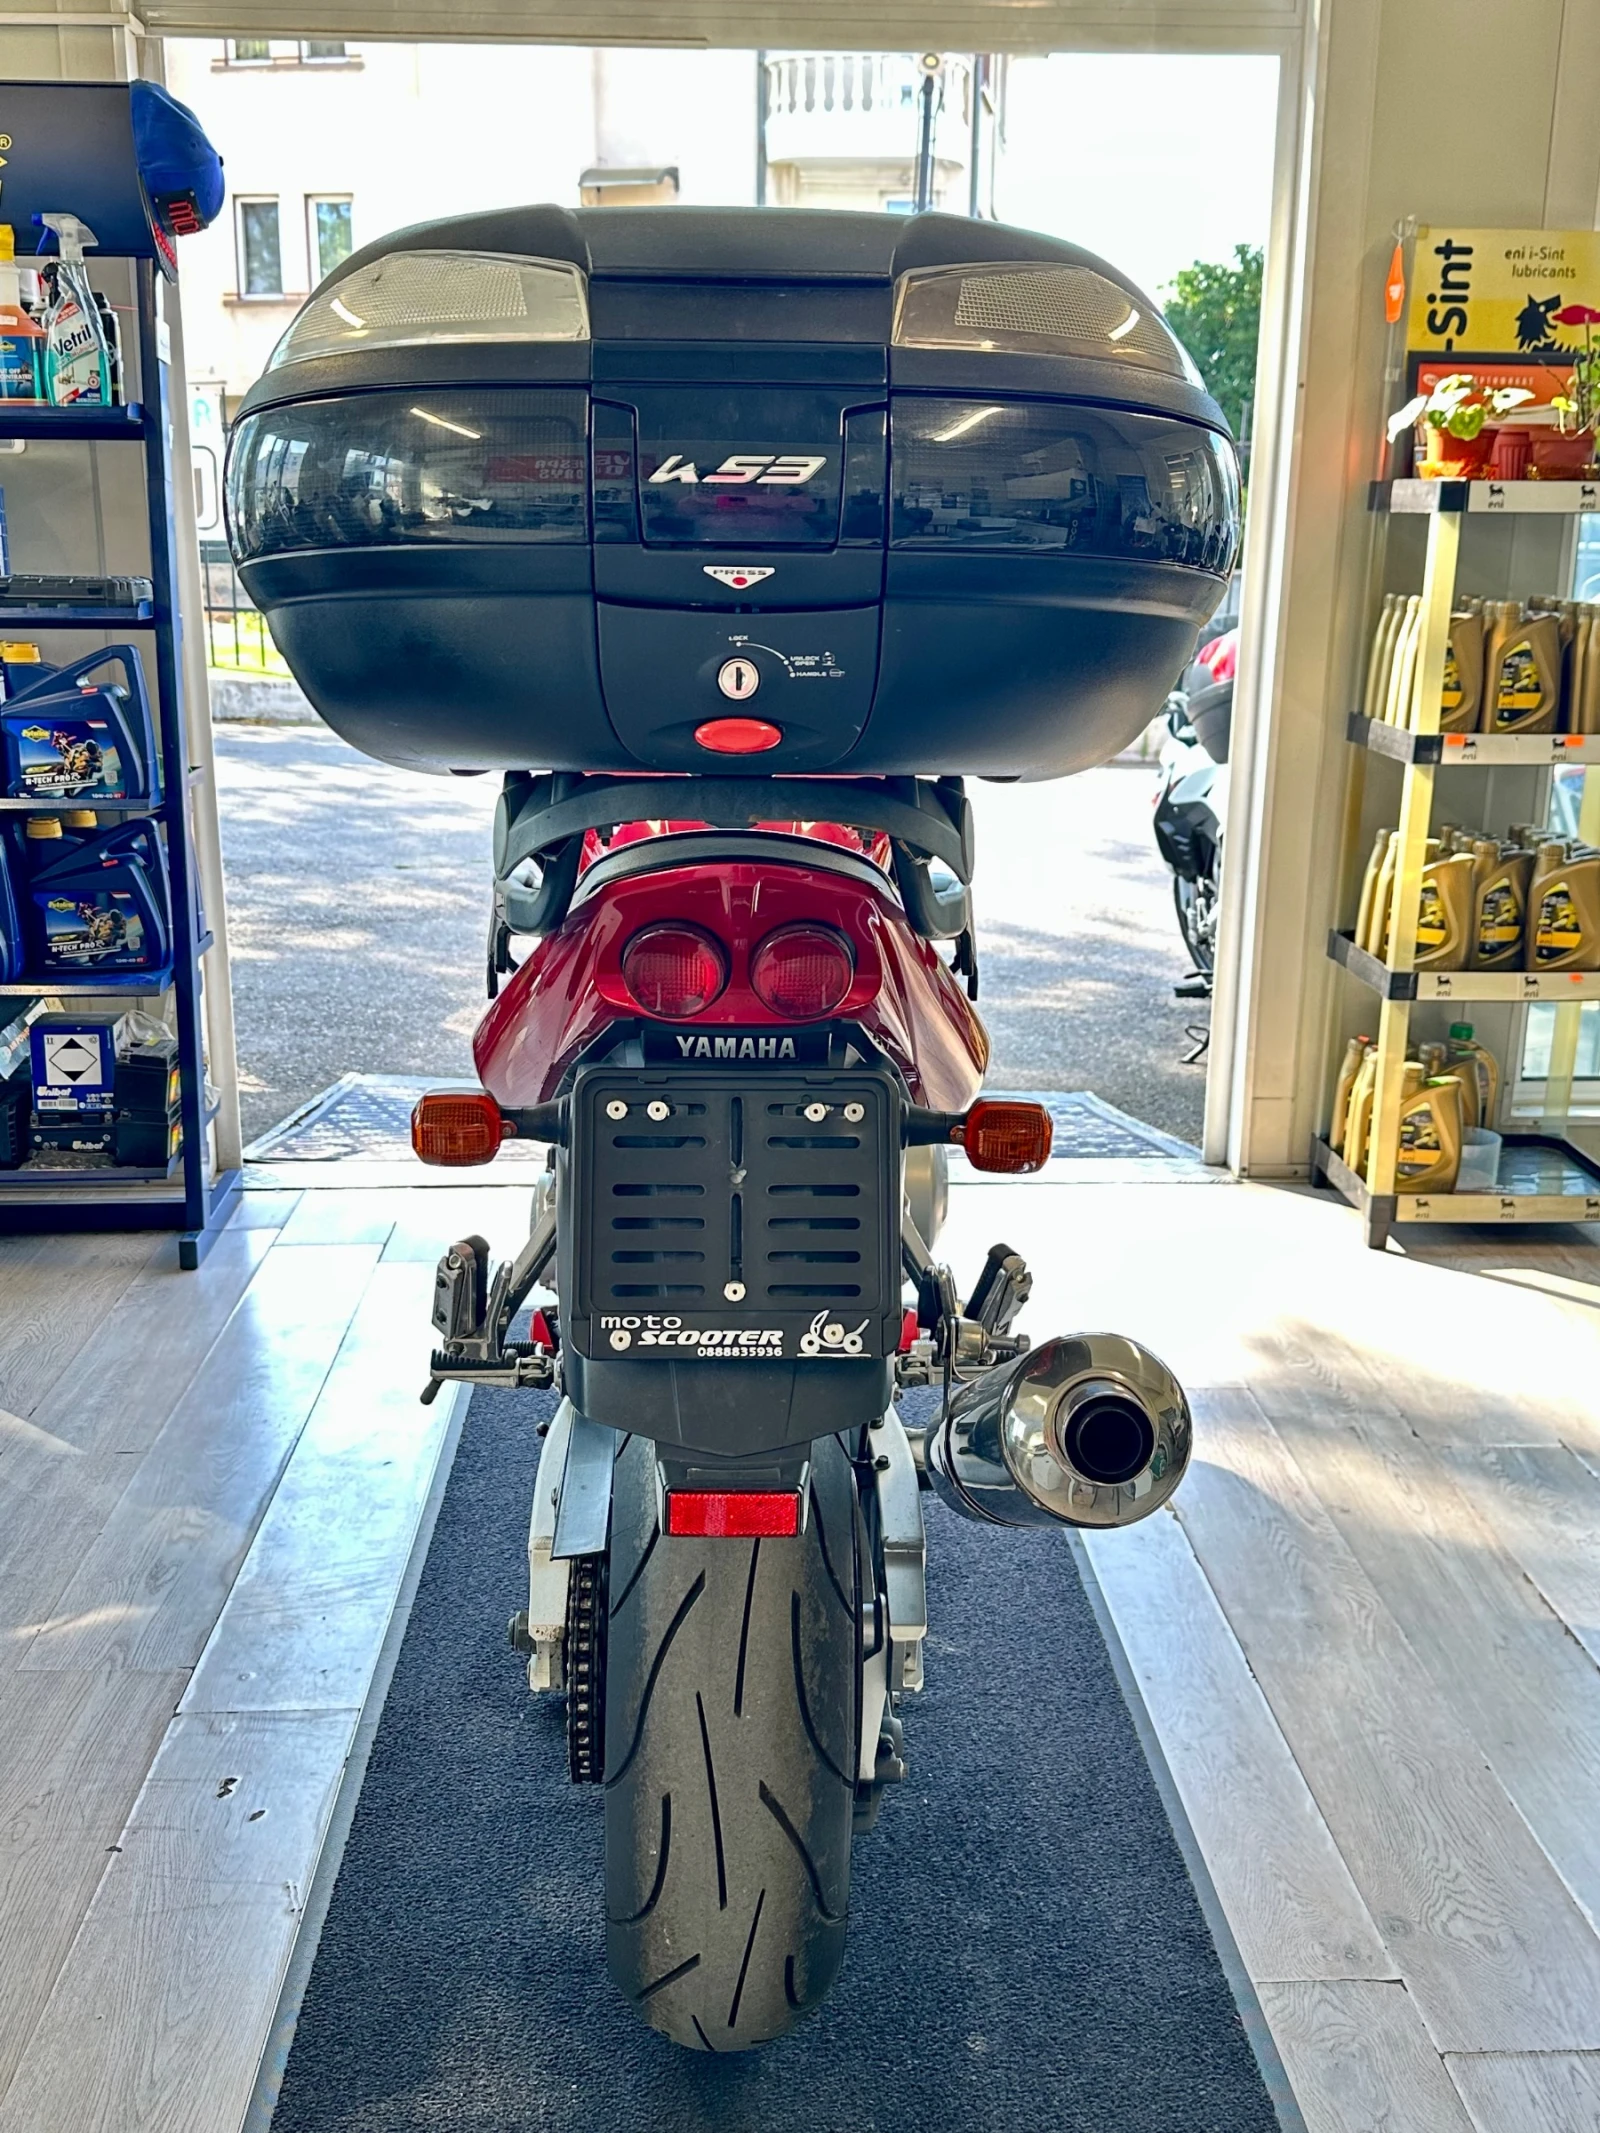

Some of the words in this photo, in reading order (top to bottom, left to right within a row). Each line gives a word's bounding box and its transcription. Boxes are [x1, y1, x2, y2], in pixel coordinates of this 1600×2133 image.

[1504, 246, 1525, 260] eni
[1528, 246, 1565, 260] i-Sint
[1512, 264, 1577, 279] lubricants
[53, 323, 92, 357] Vetril
[1488, 500, 1504, 509] eni
[1580, 501, 1596, 510] eni
[1461, 752, 1477, 761] eni
[1551, 752, 1567, 761] eni
[55, 773, 71, 783] PRO
[676, 1036, 796, 1059] YAMAHA
[37, 1086, 72, 1097] Unibat
[72, 1140, 105, 1151] Unibat
[601, 1314, 682, 1329] moto
[638, 1330, 784, 1346] SCOOTER
[697, 1347, 783, 1357] 0888835936
